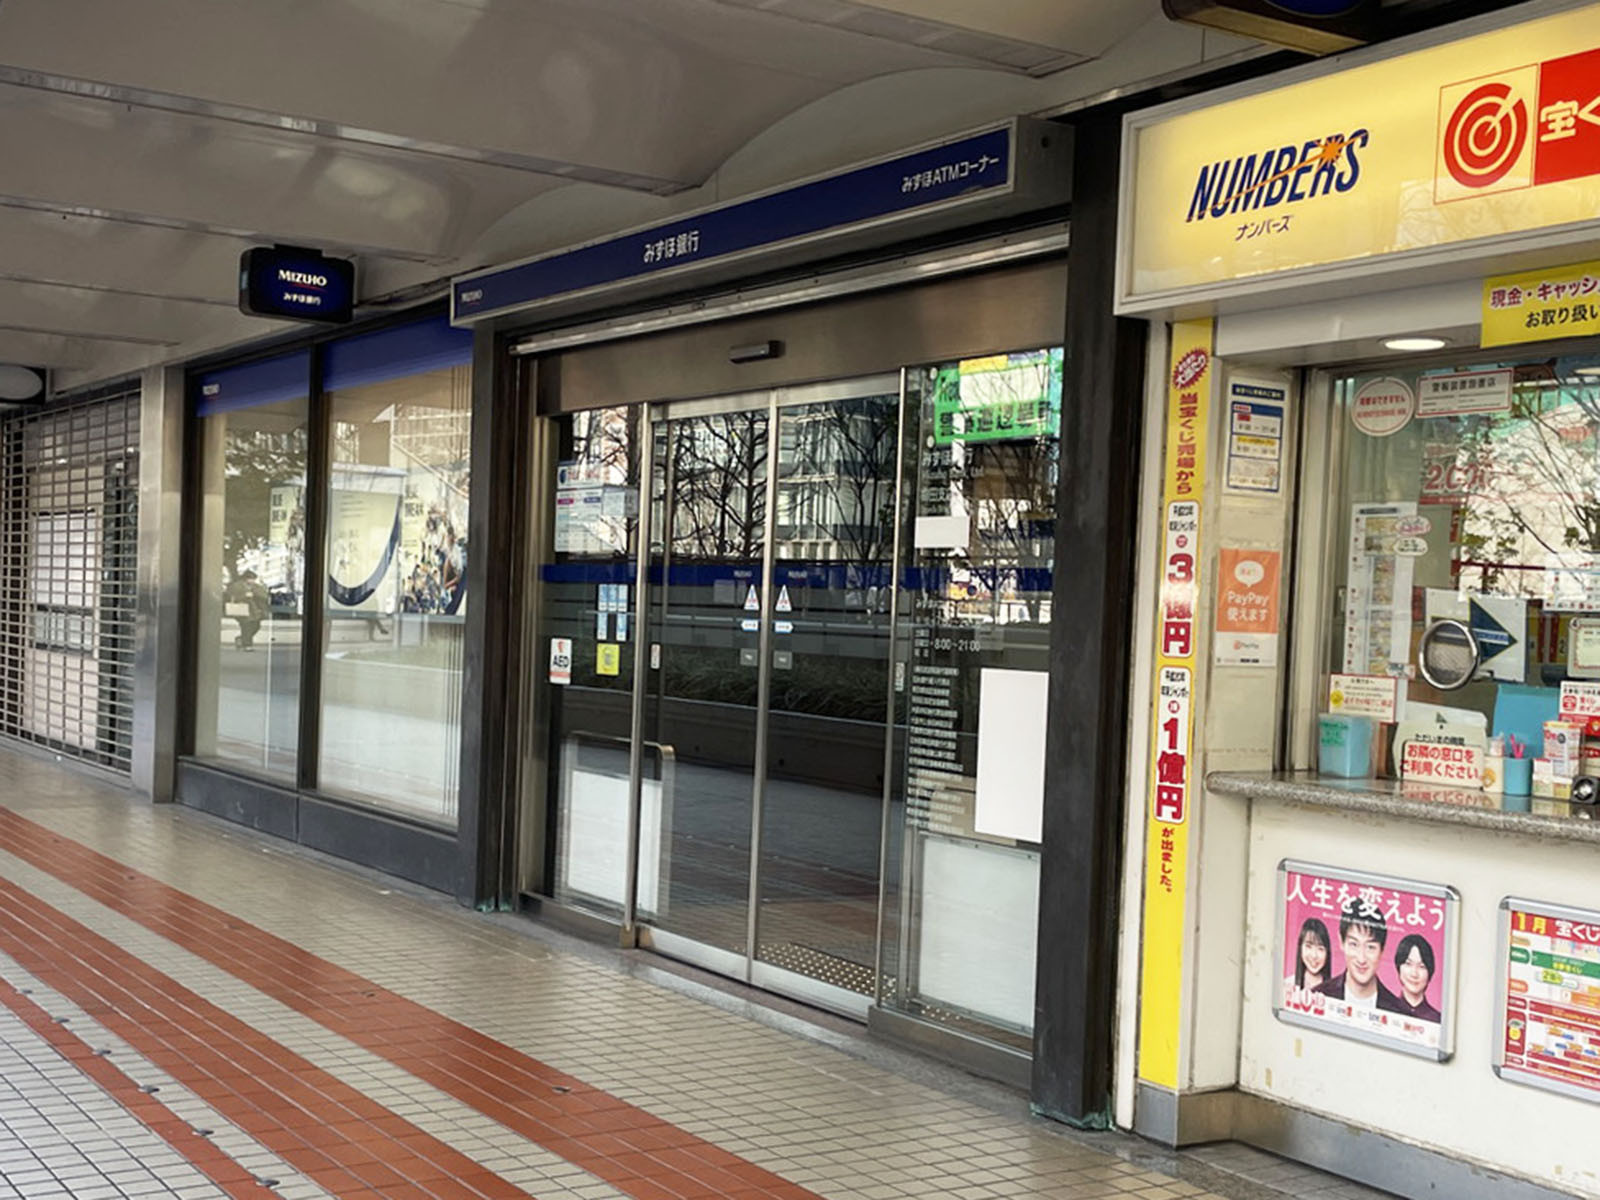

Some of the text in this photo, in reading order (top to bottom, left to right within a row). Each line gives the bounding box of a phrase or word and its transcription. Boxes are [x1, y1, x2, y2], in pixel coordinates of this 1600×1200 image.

[902, 155, 1000, 193] みずほATMコーナー
[1185, 128, 1369, 222] NUMBERS
[1236, 214, 1291, 241] ナンバーズ
[643, 230, 700, 264] みずほ銀行
[278, 269, 328, 287] MIZUHO
[1491, 277, 1600, 308] 現金・キャッシ
[1228, 591, 1269, 607] PayPay
[552, 655, 570, 668] AED
[1287, 874, 1446, 931] 人生を変えよう
